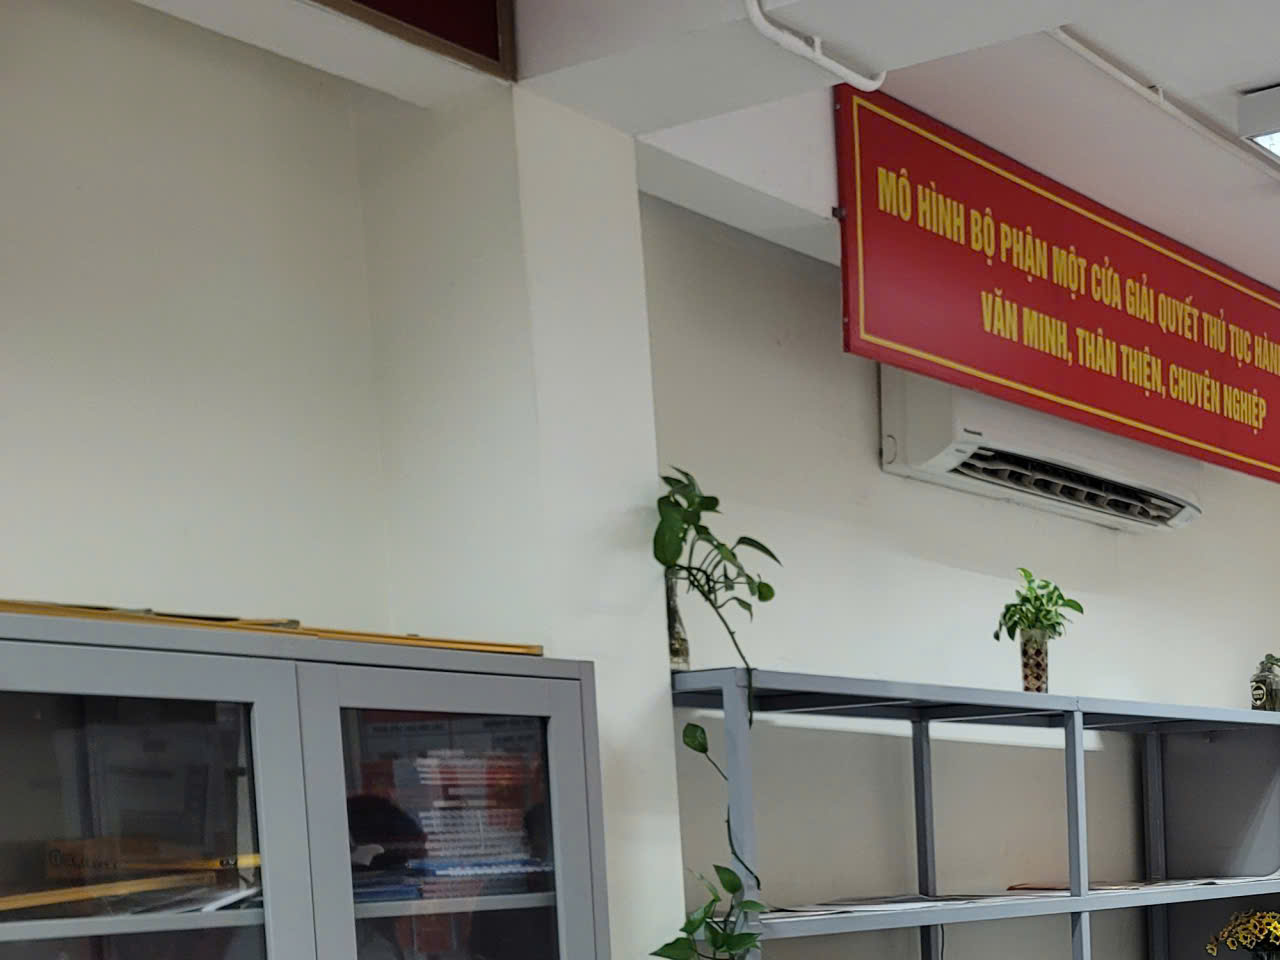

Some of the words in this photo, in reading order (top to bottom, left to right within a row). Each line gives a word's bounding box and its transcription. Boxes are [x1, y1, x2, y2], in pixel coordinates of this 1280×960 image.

[877, 166, 913, 222] MÔ
[917, 180, 966, 245] HÌNH
[970, 207, 996, 266] BỘ
[1000, 225, 1048, 283] PHẬN
[1052, 245, 1088, 300] MỘT
[1091, 255, 1122, 311] CỬA
[1125, 273, 1155, 324] GIẢI
[1158, 295, 1199, 343] QUYẾT
[1202, 308, 1226, 353] THỦ
[1229, 324, 1252, 369] TỤC
[981, 287, 1019, 343] VĂN
[1022, 306, 1072, 366] MINH,
[1075, 328, 1117, 378] THÂN
[1120, 344, 1166, 399] THIỆN,
[1169, 363, 1221, 415] CHUYÊN
[1223, 384, 1267, 435] NGHIỆP
